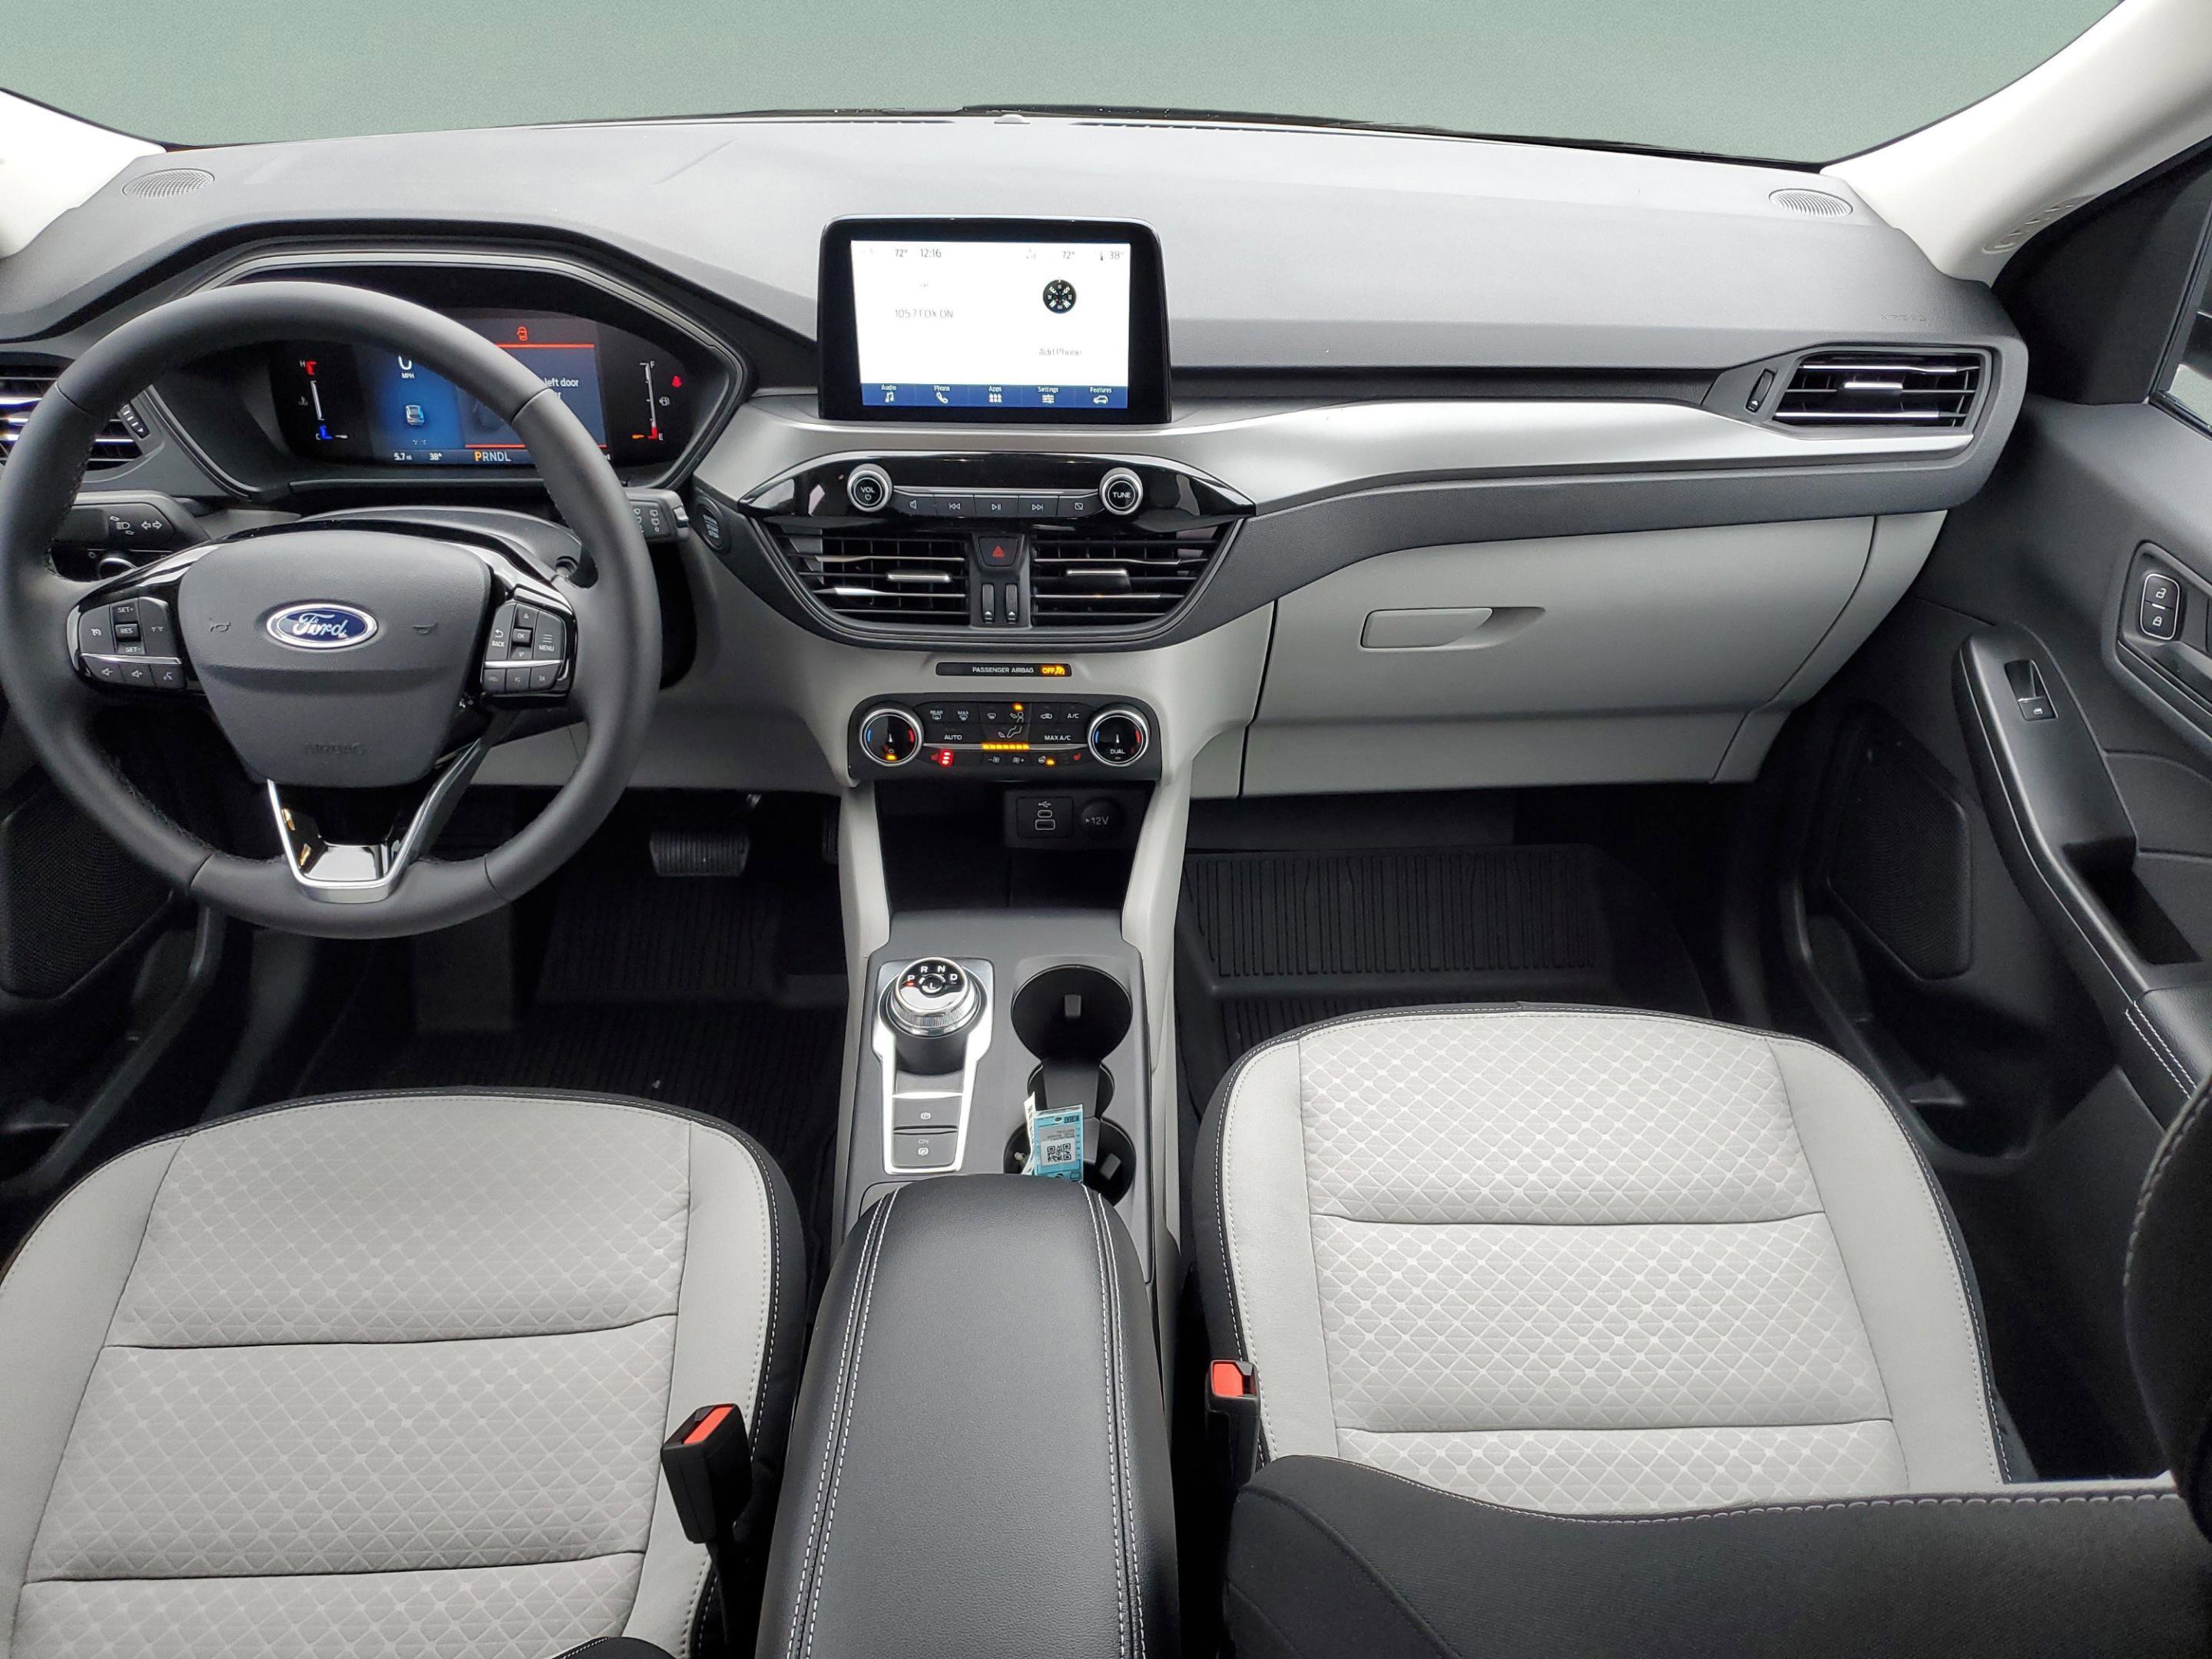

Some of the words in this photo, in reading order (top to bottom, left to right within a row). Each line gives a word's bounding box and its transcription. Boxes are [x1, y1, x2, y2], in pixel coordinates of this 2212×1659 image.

[920, 248, 942, 258] 12:16
[561, 377, 579, 387] door
[293, 613, 349, 638] Ford
[1091, 816, 1109, 826] 12V
